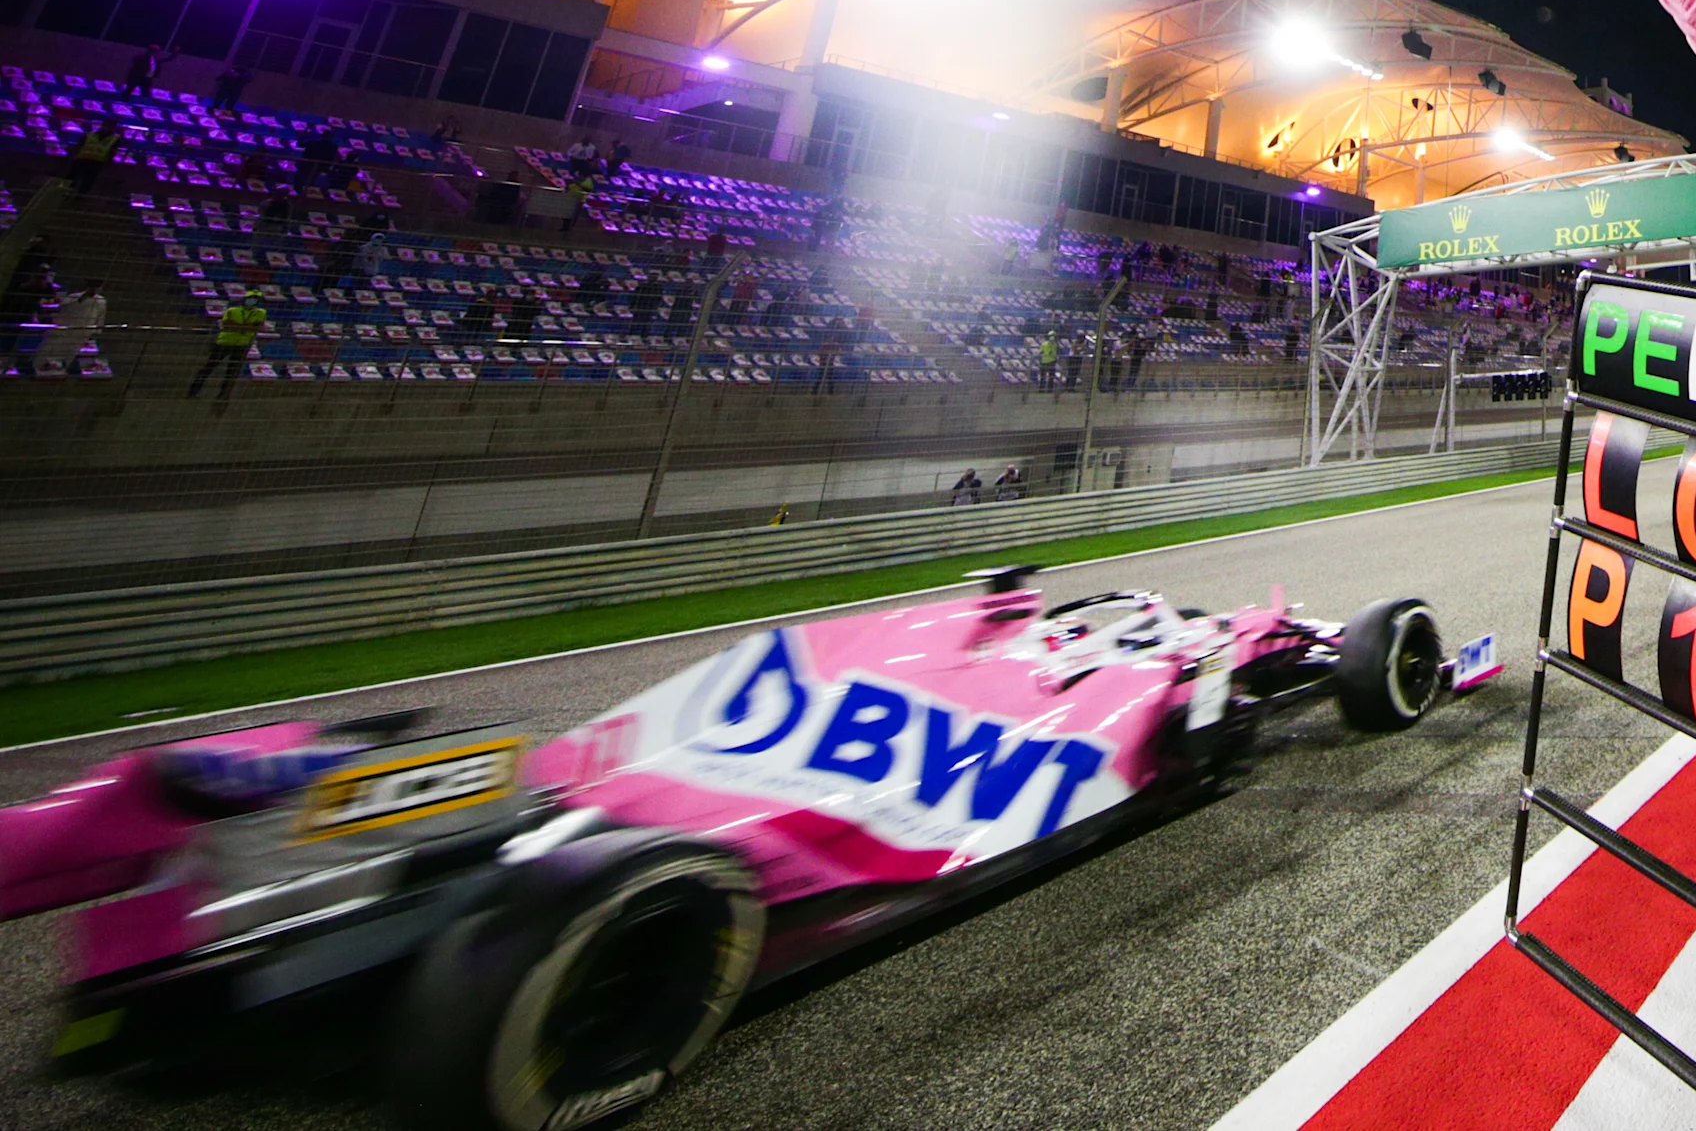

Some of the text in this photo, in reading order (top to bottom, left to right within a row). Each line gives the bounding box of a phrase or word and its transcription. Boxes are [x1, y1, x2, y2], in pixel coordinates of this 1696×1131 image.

[1419, 235, 1501, 262] ROLEX
[1555, 219, 1643, 247] ROLEX
[1582, 411, 1638, 540] L
[1568, 537, 1627, 660] P
[804, 681, 1106, 840] BWT
